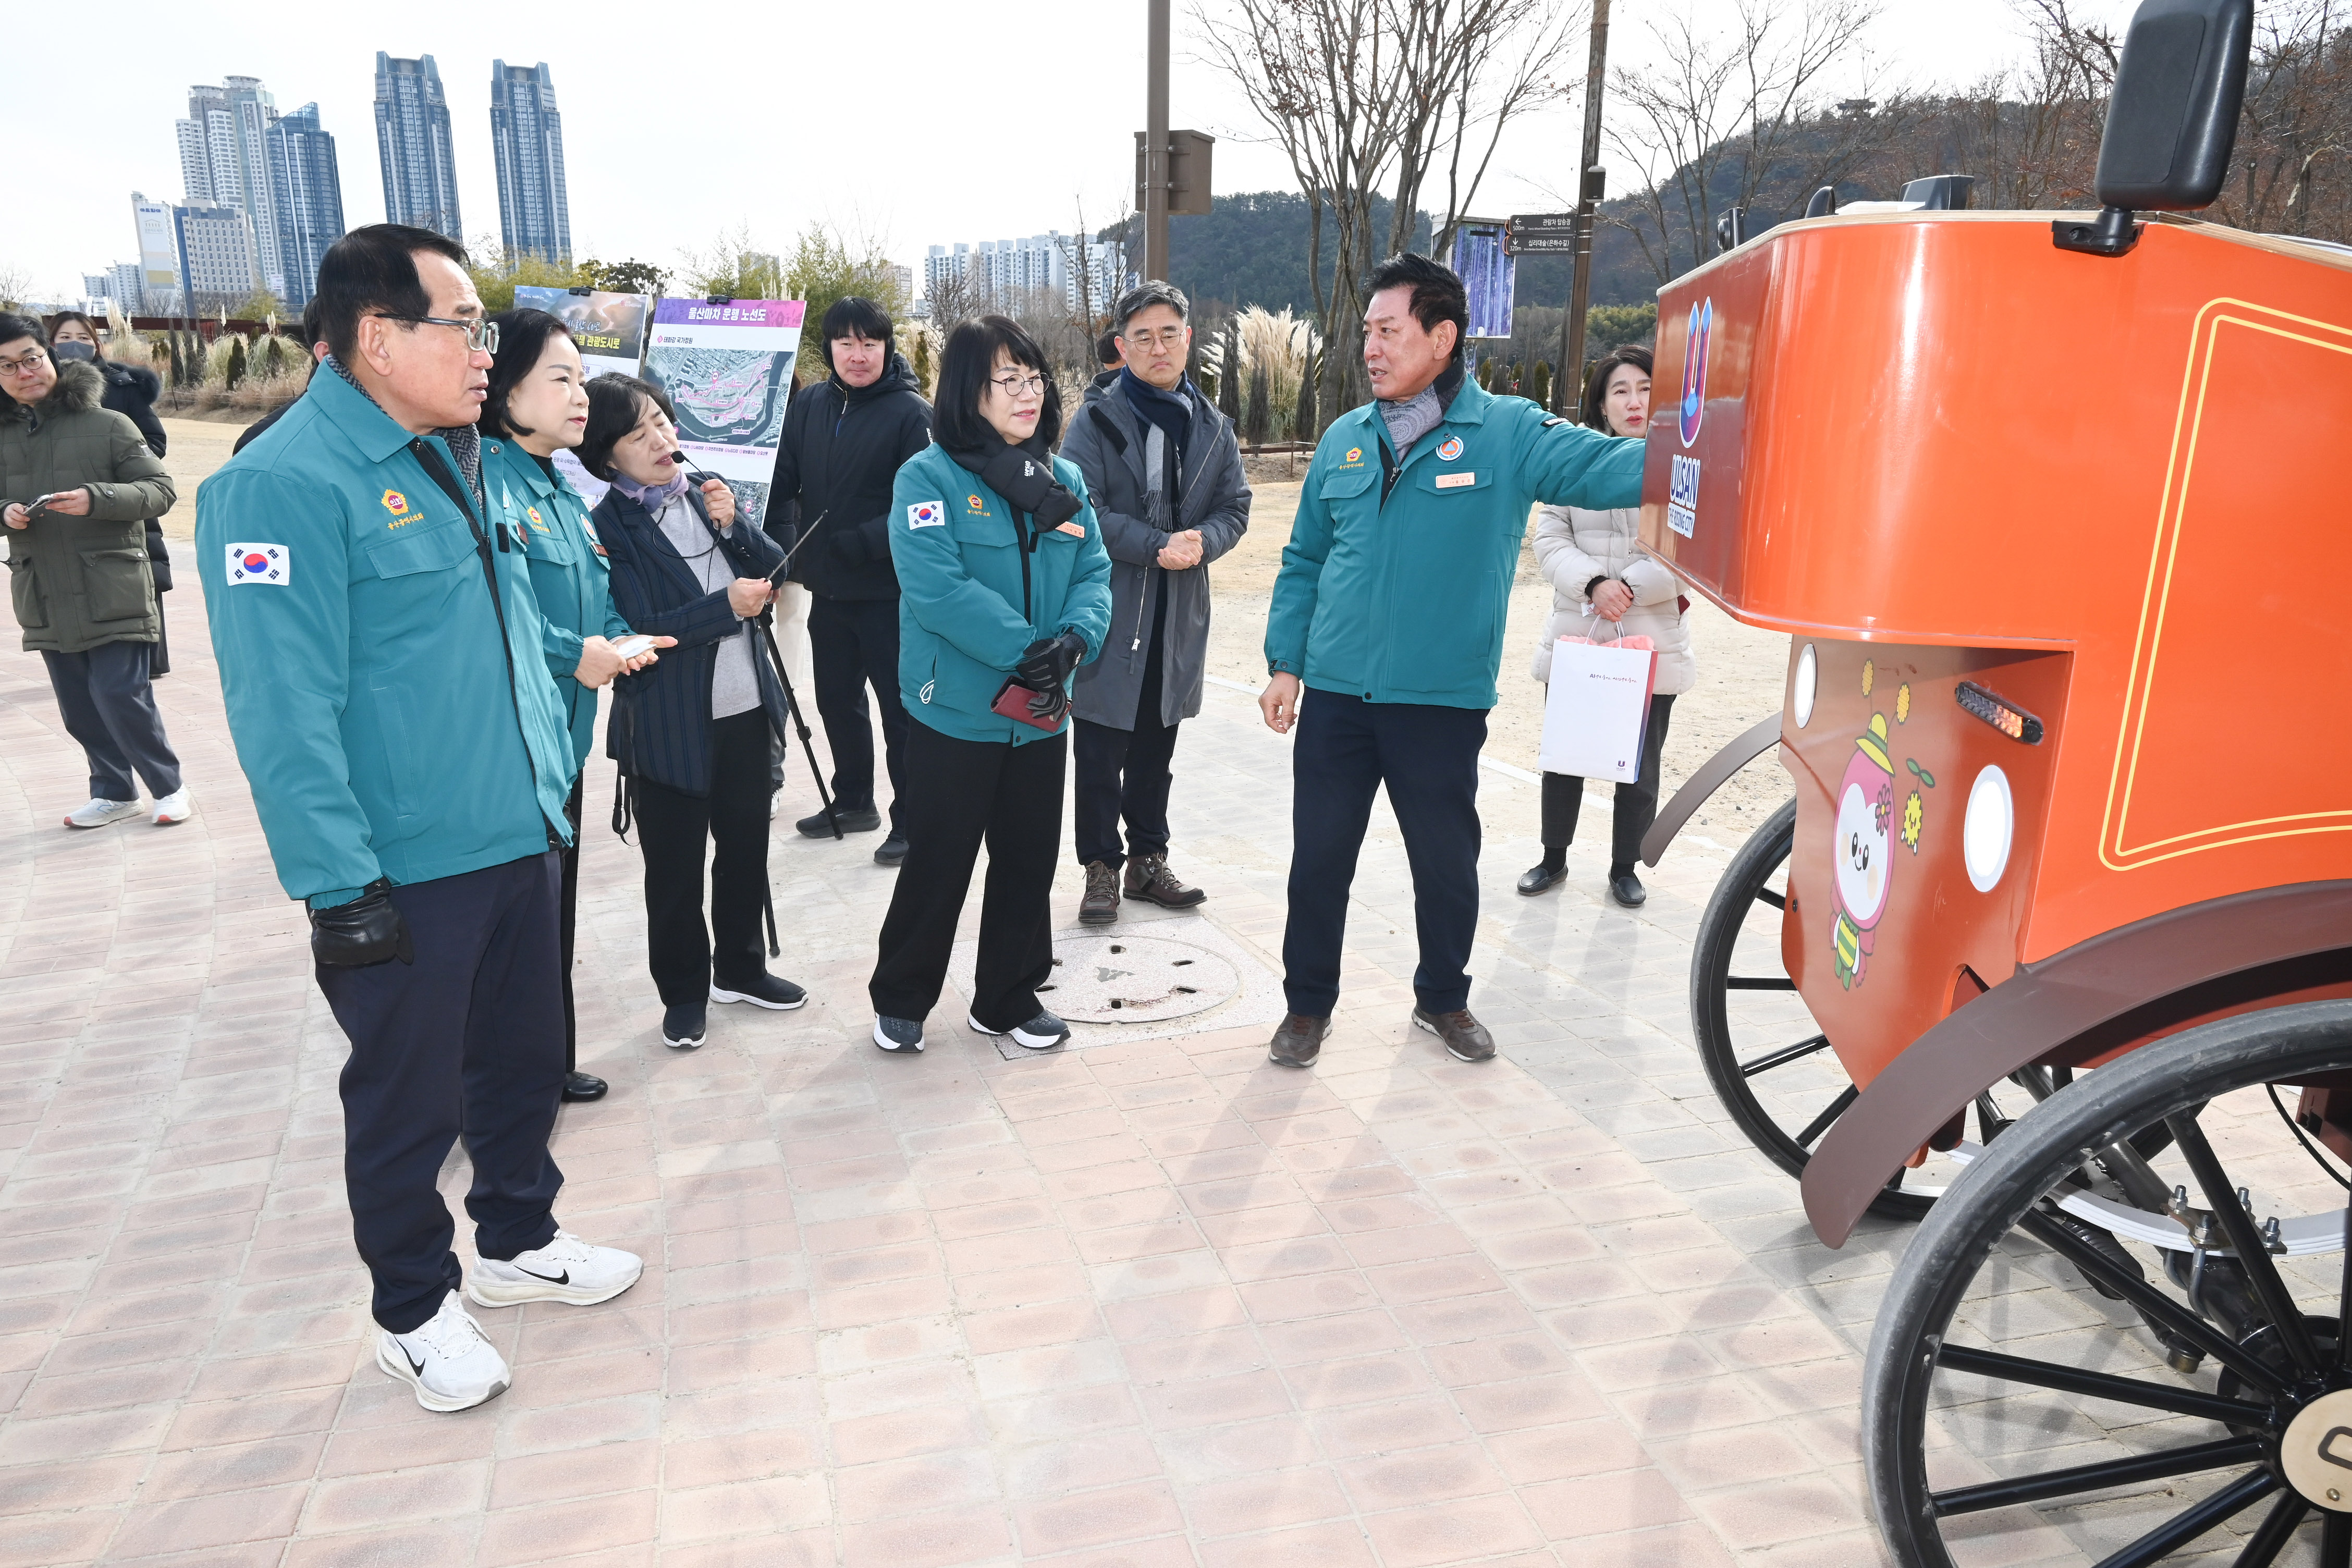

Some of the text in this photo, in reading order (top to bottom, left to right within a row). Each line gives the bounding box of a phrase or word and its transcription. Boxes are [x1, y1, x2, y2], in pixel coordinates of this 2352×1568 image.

[688, 307, 767, 322] 울산마차 운행 노선도
[587, 321, 601, 332] 60년
[587, 335, 620, 349] 관광도시로
[1671, 459, 1699, 505] ULSAN
[387, 512, 424, 530] 울산광역시의회
[1674, 510, 1685, 530] RISING
[1685, 515, 1694, 534] CITY
